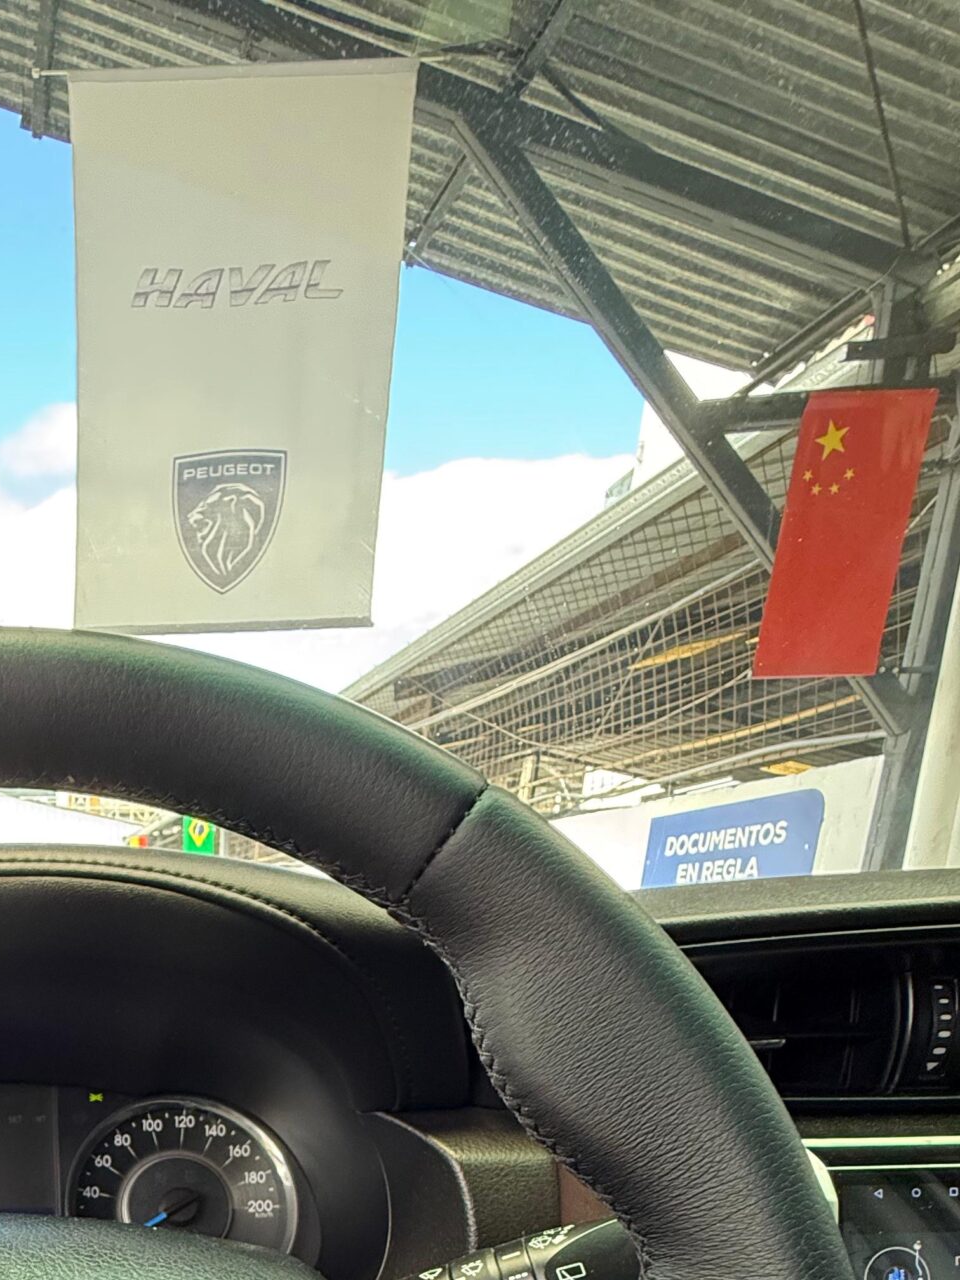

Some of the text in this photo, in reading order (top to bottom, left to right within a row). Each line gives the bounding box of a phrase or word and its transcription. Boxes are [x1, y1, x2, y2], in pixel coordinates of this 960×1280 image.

[131, 259, 344, 309] HAVAL
[182, 463, 275, 480] PEUGEOT
[664, 820, 788, 857] DOCUMENTOS
[675, 856, 759, 884] EN REGLA
[142, 1119, 163, 1131] 100
[174, 1115, 195, 1128] 120
[204, 1124, 226, 1137] 140
[114, 1133, 131, 1147] 80
[228, 1144, 250, 1157] 160
[94, 1154, 112, 1167] 60
[244, 1171, 266, 1184] 180
[82, 1186, 100, 1198] 40
[247, 1199, 273, 1213] 200
